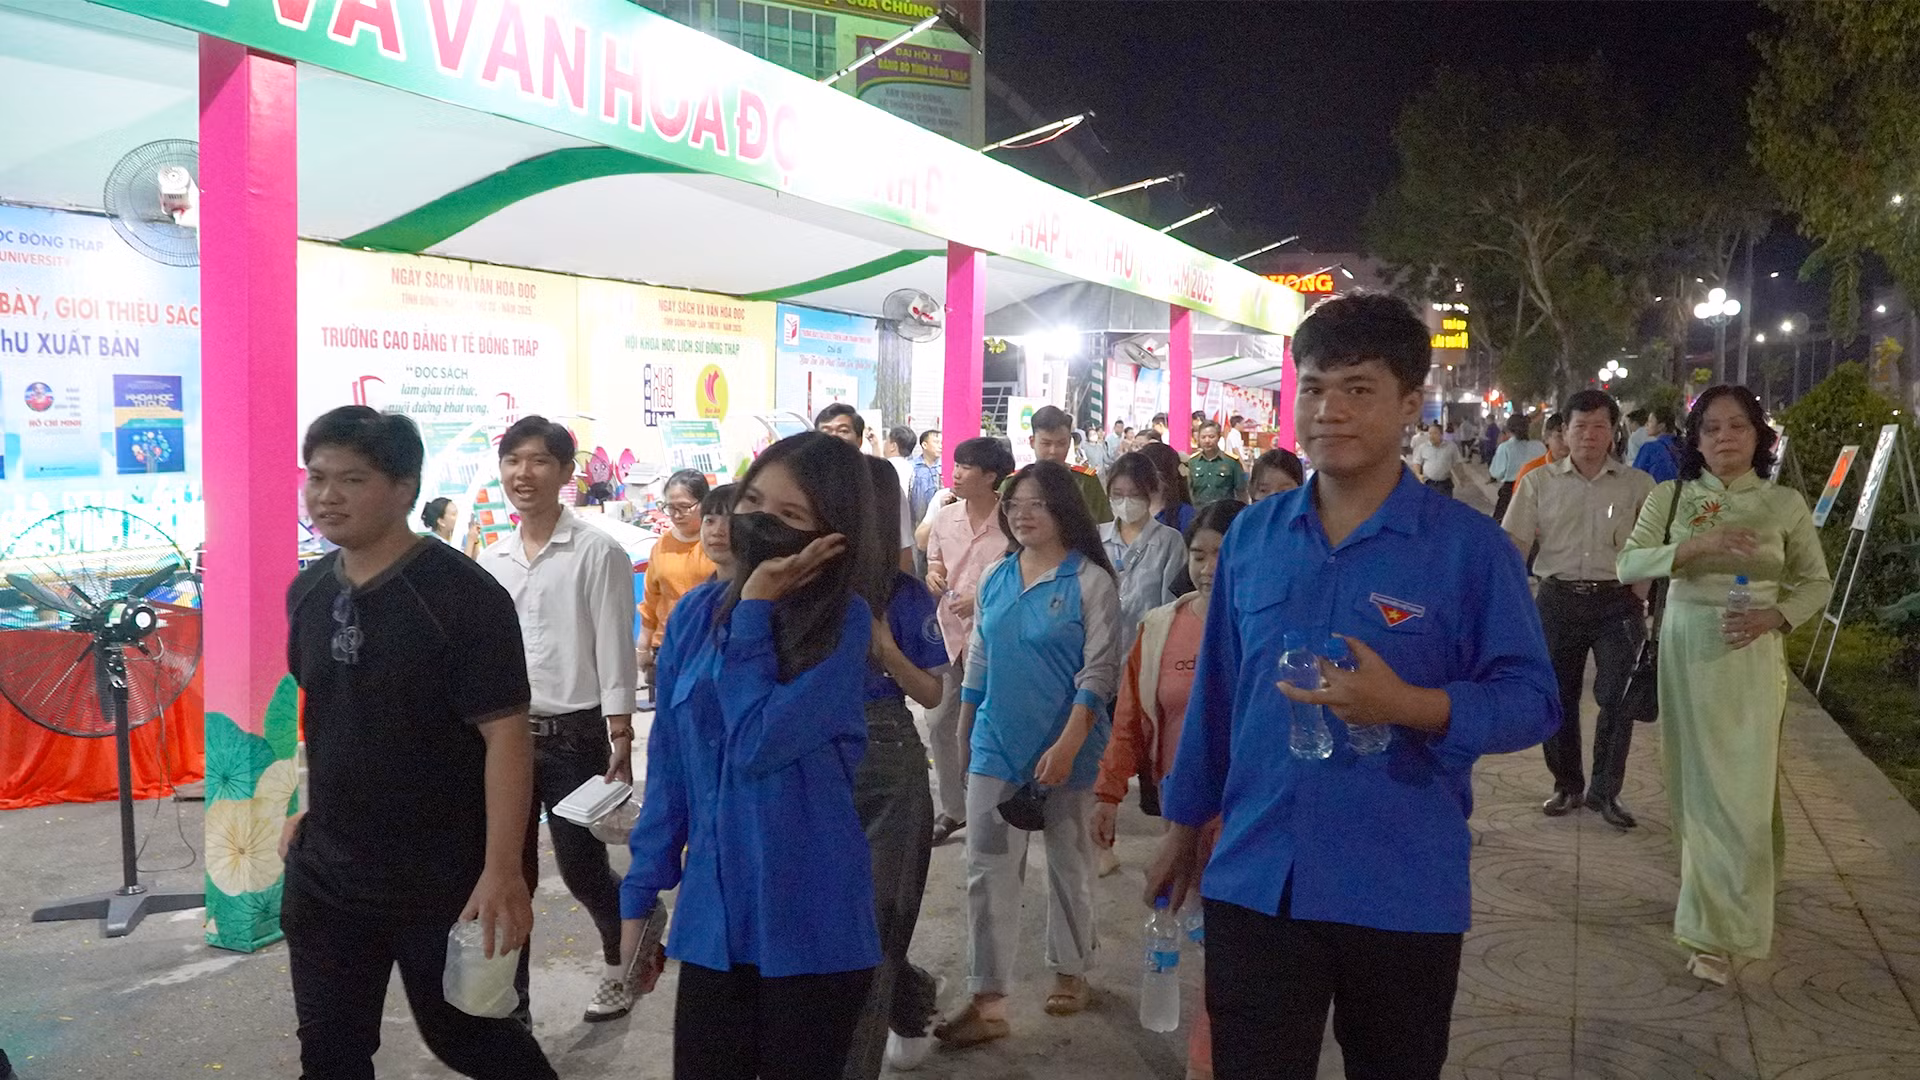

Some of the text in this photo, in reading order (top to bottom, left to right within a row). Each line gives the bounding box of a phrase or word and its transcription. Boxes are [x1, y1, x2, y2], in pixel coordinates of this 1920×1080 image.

[0, 251, 70, 266] UNIVERSIT
[321, 322, 378, 349] TRƯỜNG
[383, 329, 409, 350] CAO
[413, 322, 448, 352] ĐẲNG
[451, 334, 458, 352] Y
[640, 336, 660, 351] KHOA
